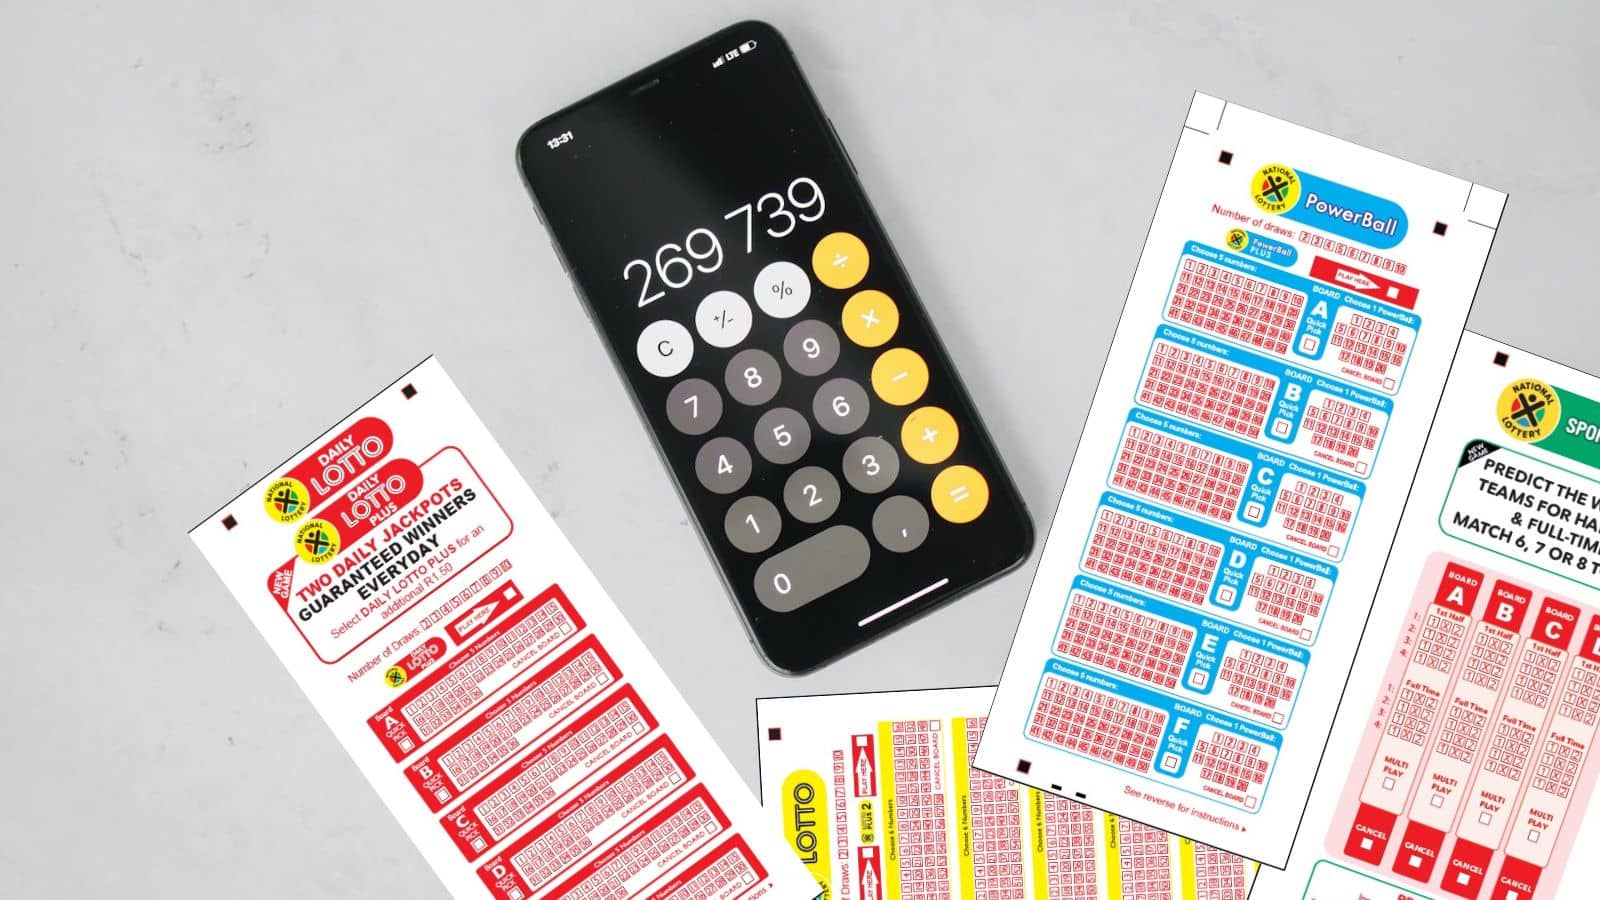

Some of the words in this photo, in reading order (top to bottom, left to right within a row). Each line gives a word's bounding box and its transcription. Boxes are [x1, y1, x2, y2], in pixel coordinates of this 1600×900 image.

[725, 49, 740, 61] LTE
[547, 131, 574, 150] 13:31
[1262, 166, 1296, 184] NATIONAL
[1255, 194, 1285, 211] LOTTERY
[1211, 203, 1251, 222] Number
[1252, 219, 1263, 227] of
[1264, 222, 1296, 239] draws:
[1305, 193, 1397, 236] PowerBall
[624, 227, 724, 308] 269
[724, 177, 827, 254] 739
[1190, 244, 1218, 259] Choose
[1250, 246, 1271, 258] PLUS
[1253, 238, 1292, 256] PowerBall
[1338, 271, 1354, 280] PLAY
[1312, 285, 1341, 300] BOARD
[1344, 295, 1371, 310] Choose
[1310, 300, 1328, 320] A
[1306, 316, 1327, 330] Quick
[1306, 324, 1322, 335] Pick
[658, 340, 673, 357] C
[803, 338, 820, 359] 9
[744, 367, 762, 388] 8
[1284, 368, 1313, 384] BOARD
[1341, 366, 1362, 378] CANCEL
[1363, 374, 1383, 385] BOARD
[1284, 382, 1302, 402] B
[1512, 381, 1553, 404] NATIONAL
[684, 395, 698, 419] 7
[832, 396, 850, 417] 6
[773, 425, 792, 447] 5
[1502, 416, 1540, 438] LOTTERY
[317, 434, 354, 467] DAILY
[1257, 452, 1285, 466] BOARD
[310, 435, 384, 496] LOTTO
[717, 454, 733, 475] 4
[863, 455, 880, 476] 3
[1257, 467, 1275, 485] C
[1483, 458, 1554, 492] PREDICT
[1557, 483, 1588, 506] THE
[267, 481, 293, 502] NATIONAL
[347, 473, 379, 502] DAILY
[803, 484, 823, 507] 2
[281, 501, 306, 521] LOTTERY
[340, 474, 406, 528] LOTTO
[1479, 477, 1535, 508] TEAMS
[1536, 499, 1572, 522] FOR
[1574, 513, 1600, 534] HA
[369, 501, 398, 526] PLUS
[1510, 511, 1522, 526] &
[297, 522, 323, 544] NATIONAL
[745, 515, 760, 534] 1
[295, 573, 332, 602] TWO
[332, 538, 377, 578] DAILY
[383, 478, 463, 542] JACKPOTS
[1453, 511, 1513, 543] MATCH
[1515, 535, 1528, 552] 6,
[1534, 541, 1546, 554] 7
[1548, 546, 1574, 565] OR
[1576, 556, 1588, 570] 8
[298, 542, 402, 621] GUARANTEED
[402, 488, 476, 545] WINNERS
[311, 542, 337, 562] LOTTERY
[1229, 549, 1249, 571] D
[356, 533, 439, 600] EVERYDAY
[273, 570, 284, 594] NEW
[280, 569, 292, 599] GAME
[330, 613, 362, 639] Select
[359, 589, 391, 618] DAILY
[391, 565, 427, 594] LOTTO
[427, 544, 457, 569] PLUS
[455, 534, 470, 548] for
[471, 525, 485, 538] an
[773, 573, 792, 595] 0
[1448, 571, 1478, 586] BOARD
[380, 582, 425, 619] additional
[423, 562, 453, 587] R1.50
[1446, 586, 1463, 606] A
[1497, 589, 1526, 604] BOARD
[1436, 607, 1448, 617] 1st
[1449, 613, 1465, 622] Half
[1495, 602, 1514, 622] B
[1545, 606, 1574, 621] BOARD
[457, 618, 474, 632] PLAY
[1545, 621, 1563, 639] C
[448, 652, 470, 669] Choose
[474, 630, 501, 651] Numbers
[512, 649, 538, 669] CANCEL
[537, 632, 560, 650] BOARD
[1201, 633, 1220, 654] E
[347, 654, 382, 683] Number
[382, 645, 392, 658] of
[406, 644, 439, 671] LOTTO
[1406, 679, 1421, 690] Full
[1422, 685, 1440, 697] Time
[374, 705, 394, 722] Board
[1174, 703, 1202, 717] BOARD
[385, 715, 399, 730] A
[385, 721, 406, 738] QUICK
[1173, 717, 1190, 737] F
[392, 730, 407, 742] PICK
[931, 732, 939, 759] BOARD
[419, 765, 433, 779] B
[933, 760, 941, 790] CANCEL
[1123, 785, 1142, 798] See
[1143, 793, 1176, 809] reverse
[1177, 803, 1190, 813] for
[1190, 807, 1239, 831] instructions
[1529, 808, 1554, 822] MULTI
[455, 814, 469, 828] C
[793, 782, 818, 865] LOTTO
[1527, 818, 1548, 830] PLAY
[1355, 823, 1386, 840] CANCEL
[491, 865, 506, 879] D
[1500, 876, 1531, 893] CANCEL
